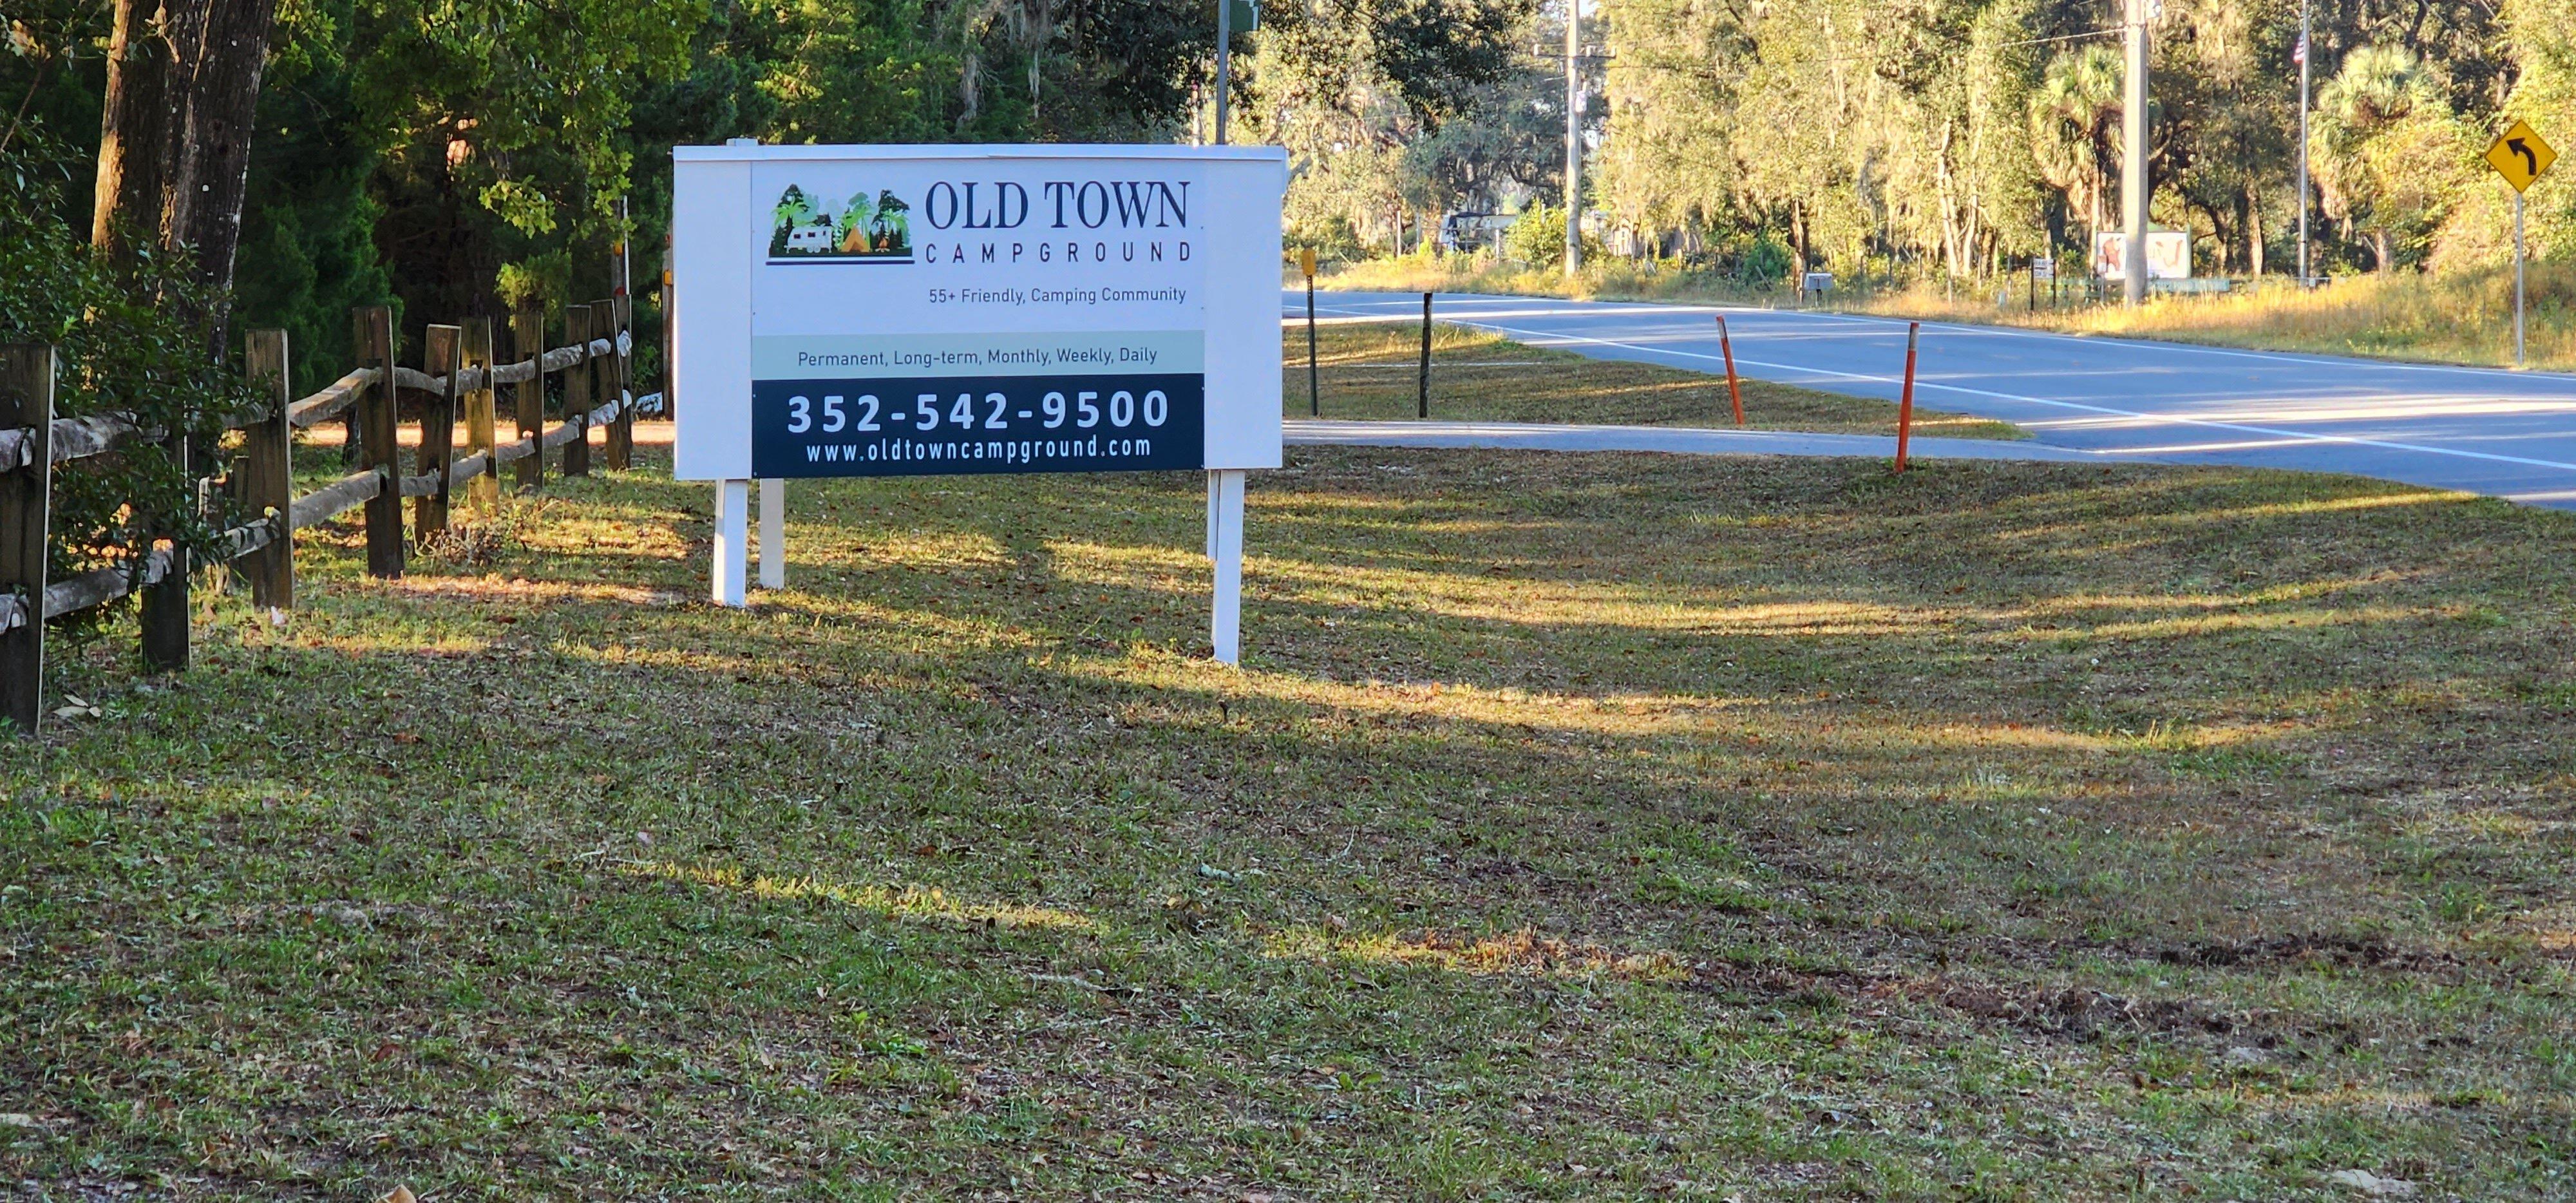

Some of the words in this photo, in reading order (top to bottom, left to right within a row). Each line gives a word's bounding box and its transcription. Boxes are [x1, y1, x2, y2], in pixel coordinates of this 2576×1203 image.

[926, 182, 1028, 229] OLD
[1045, 181, 1190, 229] TOWN
[926, 242, 1189, 263] CAMPGROUND
[929, 289, 955, 303] 55+
[961, 289, 1026, 306] Friendly,
[1031, 287, 1096, 305] Camping
[1102, 286, 1186, 305] Community
[799, 352, 888, 368] Permanent,
[894, 350, 982, 368] Long-term,
[988, 349, 1052, 366] Monthly,
[1056, 348, 1114, 365] Weekly,
[1120, 346, 1157, 365] Daily
[788, 390, 1168, 433] 352-542-9500
[806, 435, 1151, 464] www.oldtowncampground.com
